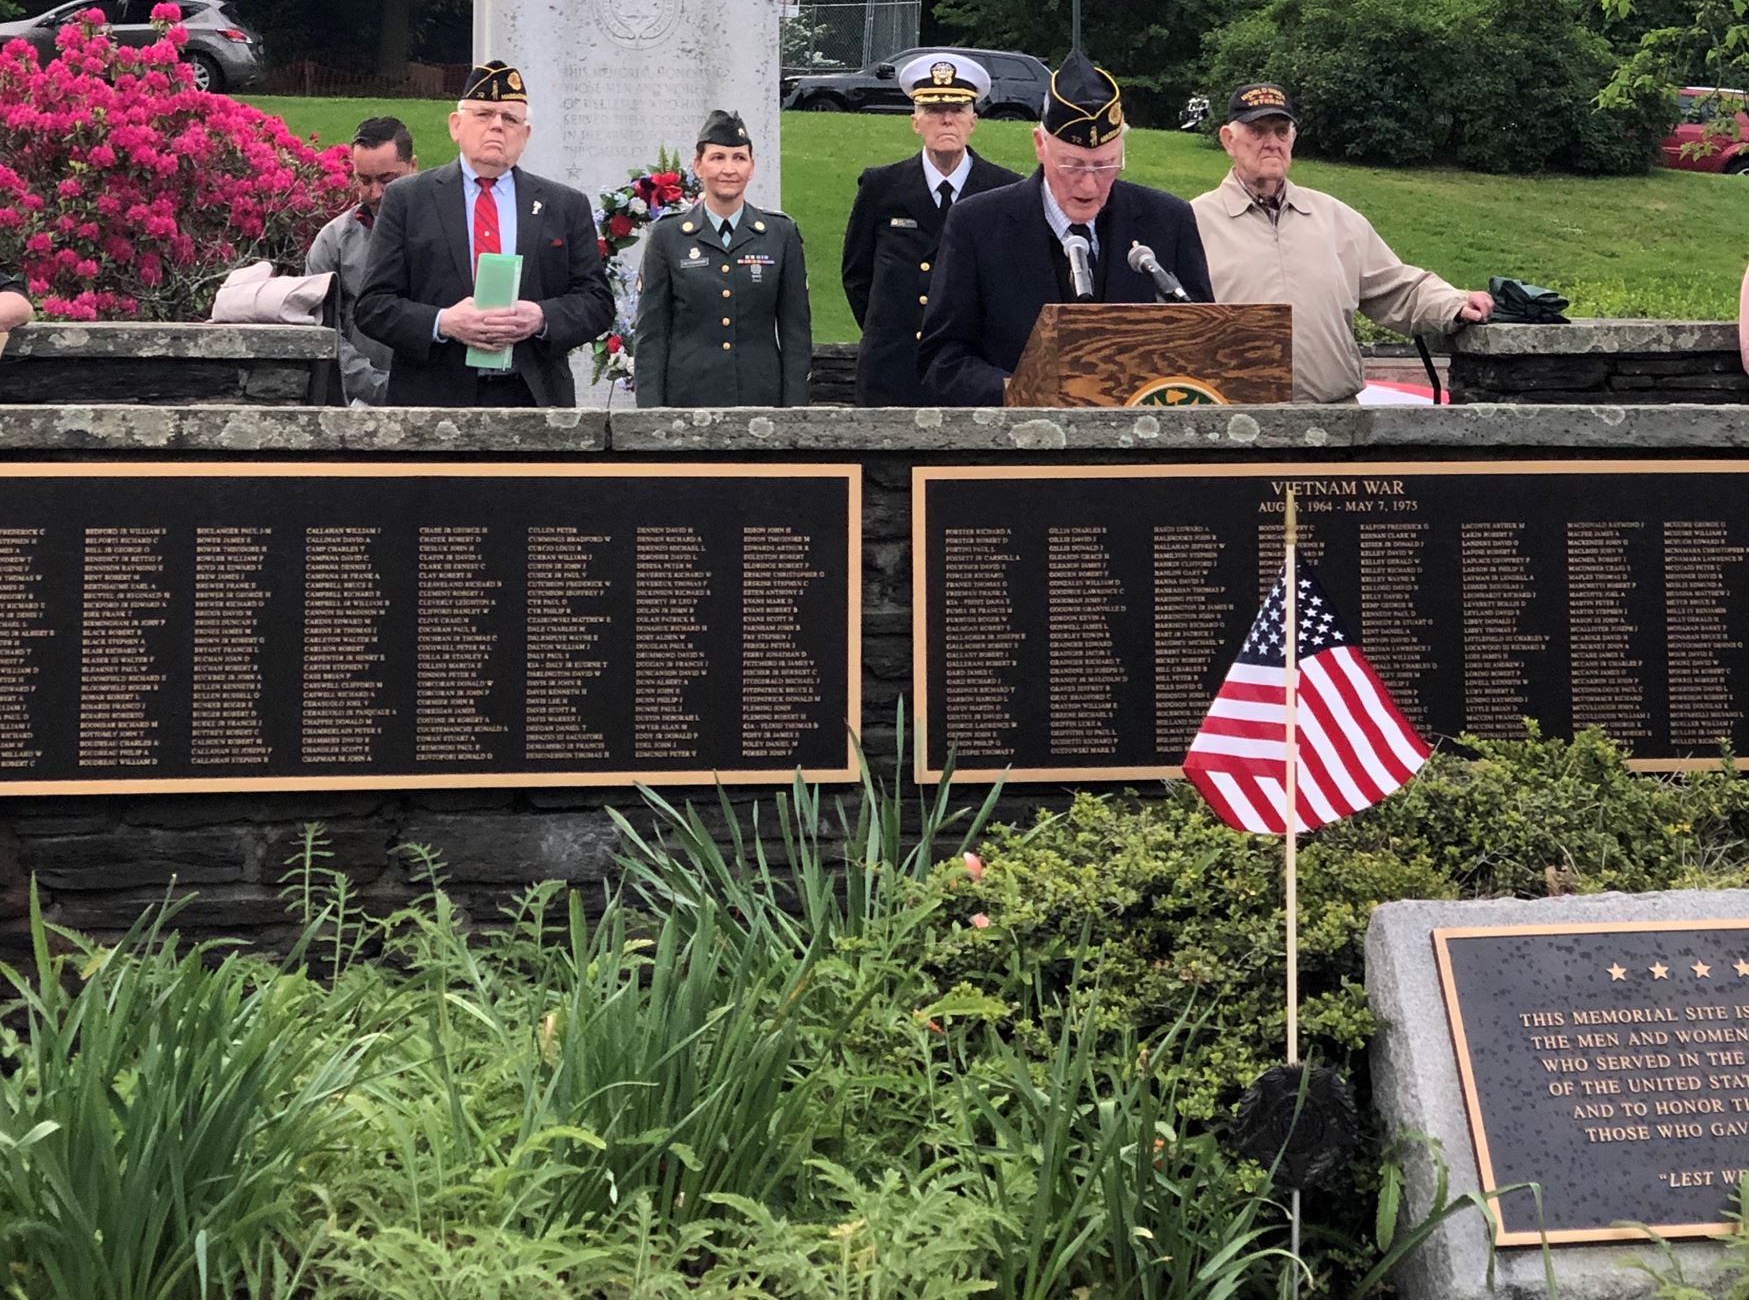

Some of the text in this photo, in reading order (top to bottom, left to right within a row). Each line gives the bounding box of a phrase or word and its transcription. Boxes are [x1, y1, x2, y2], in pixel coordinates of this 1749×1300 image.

[1271, 480, 1405, 496] VIETNAM WAR
[1258, 501, 1285, 513] AUG
[1308, 501, 1333, 512] 1964
[1345, 500, 1374, 512] MAY
[1378, 501, 1389, 512] 7,
[1393, 500, 1418, 512] 1975
[1519, 1011, 1565, 1028] THIS
[1572, 1008, 1679, 1026] MEMORIAL
[1685, 1005, 1729, 1021] SITE
[1531, 1028, 1749, 1050] THE MEN AND WOMEN
[1541, 1051, 1746, 1073] WHO SERVED IN THE
[1549, 1082, 1575, 1097] OF
[1581, 1080, 1621, 1095] THE
[1628, 1076, 1701, 1093] UNITED
[1573, 1103, 1615, 1120] AND
[1620, 1102, 1648, 1117] TO
[1655, 1098, 1725, 1115] HONOR
[1585, 1126, 1650, 1143] THOSE
[1656, 1124, 1703, 1139] WHO
